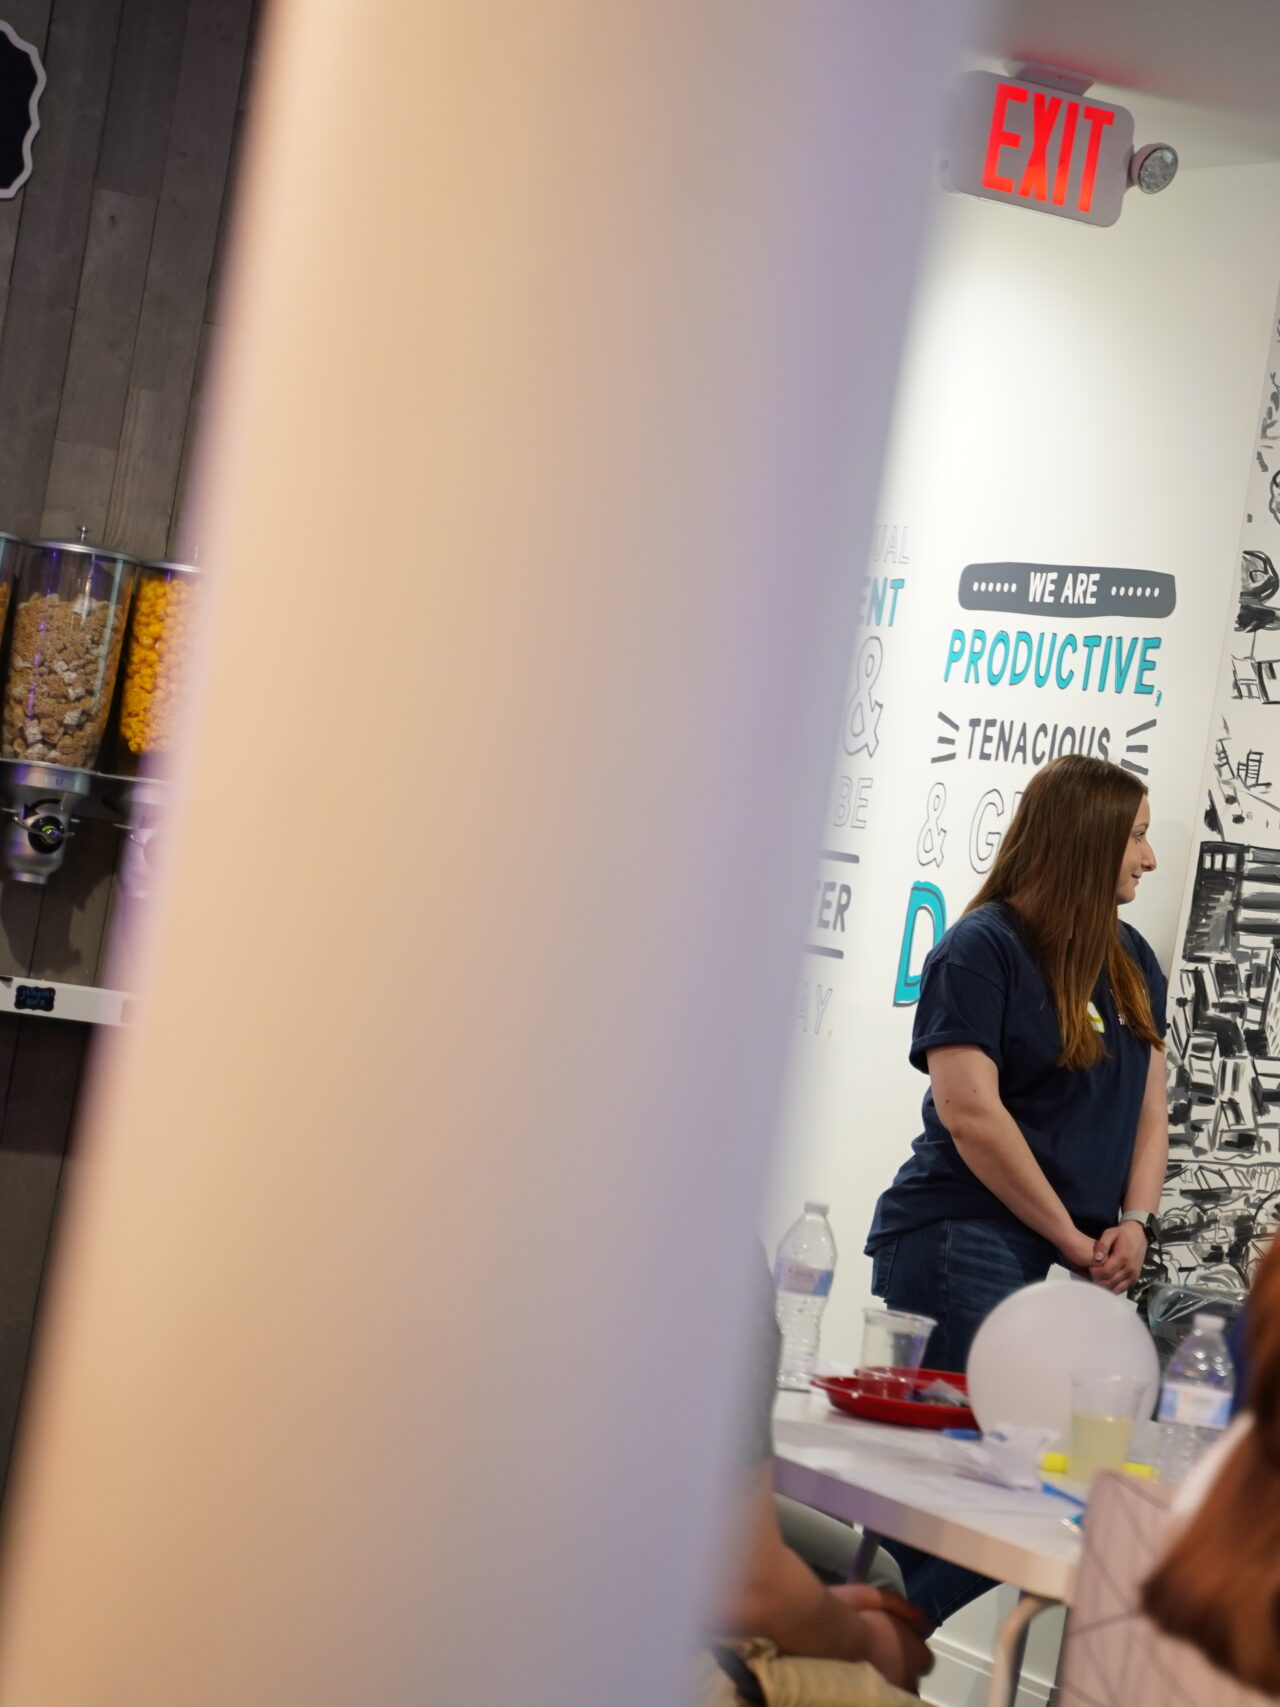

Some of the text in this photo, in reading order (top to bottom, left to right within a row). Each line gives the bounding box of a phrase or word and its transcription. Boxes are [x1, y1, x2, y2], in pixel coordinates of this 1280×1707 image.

[981, 82, 1115, 213] EXIT
[1028, 572, 1101, 606] WE ARE
[943, 628, 1163, 708] PRODUCTIVE,
[967, 717, 1112, 766] TENACIOUS
[916, 782, 947, 868] &
